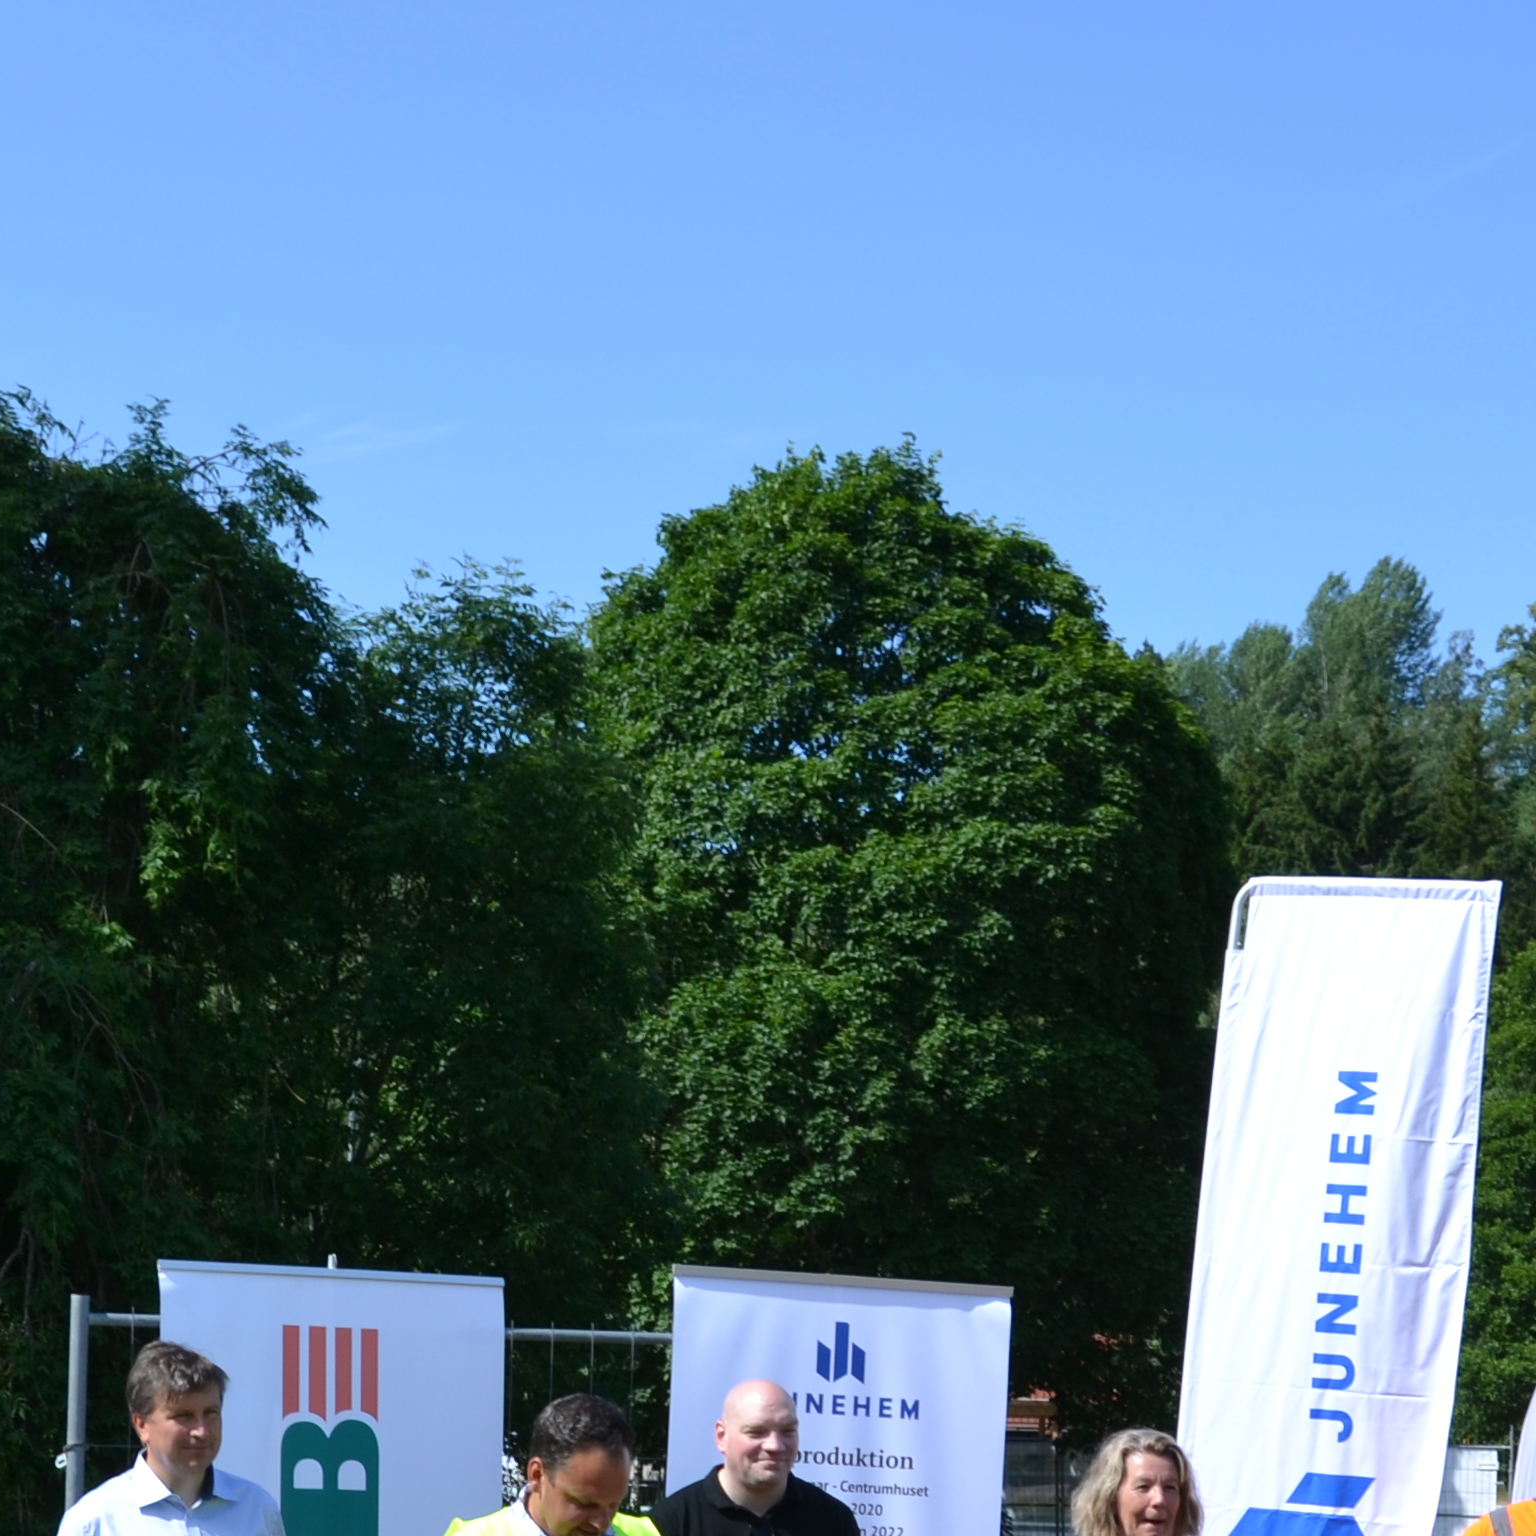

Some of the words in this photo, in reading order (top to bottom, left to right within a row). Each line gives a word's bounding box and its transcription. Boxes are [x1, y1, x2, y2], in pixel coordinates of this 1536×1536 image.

[1310, 1071, 1379, 1443] JUNEHEM
[793, 1392, 920, 1420] NEHEM
[840, 1480, 929, 1497] Centrumhuset
[851, 1503, 883, 1516] 2020
